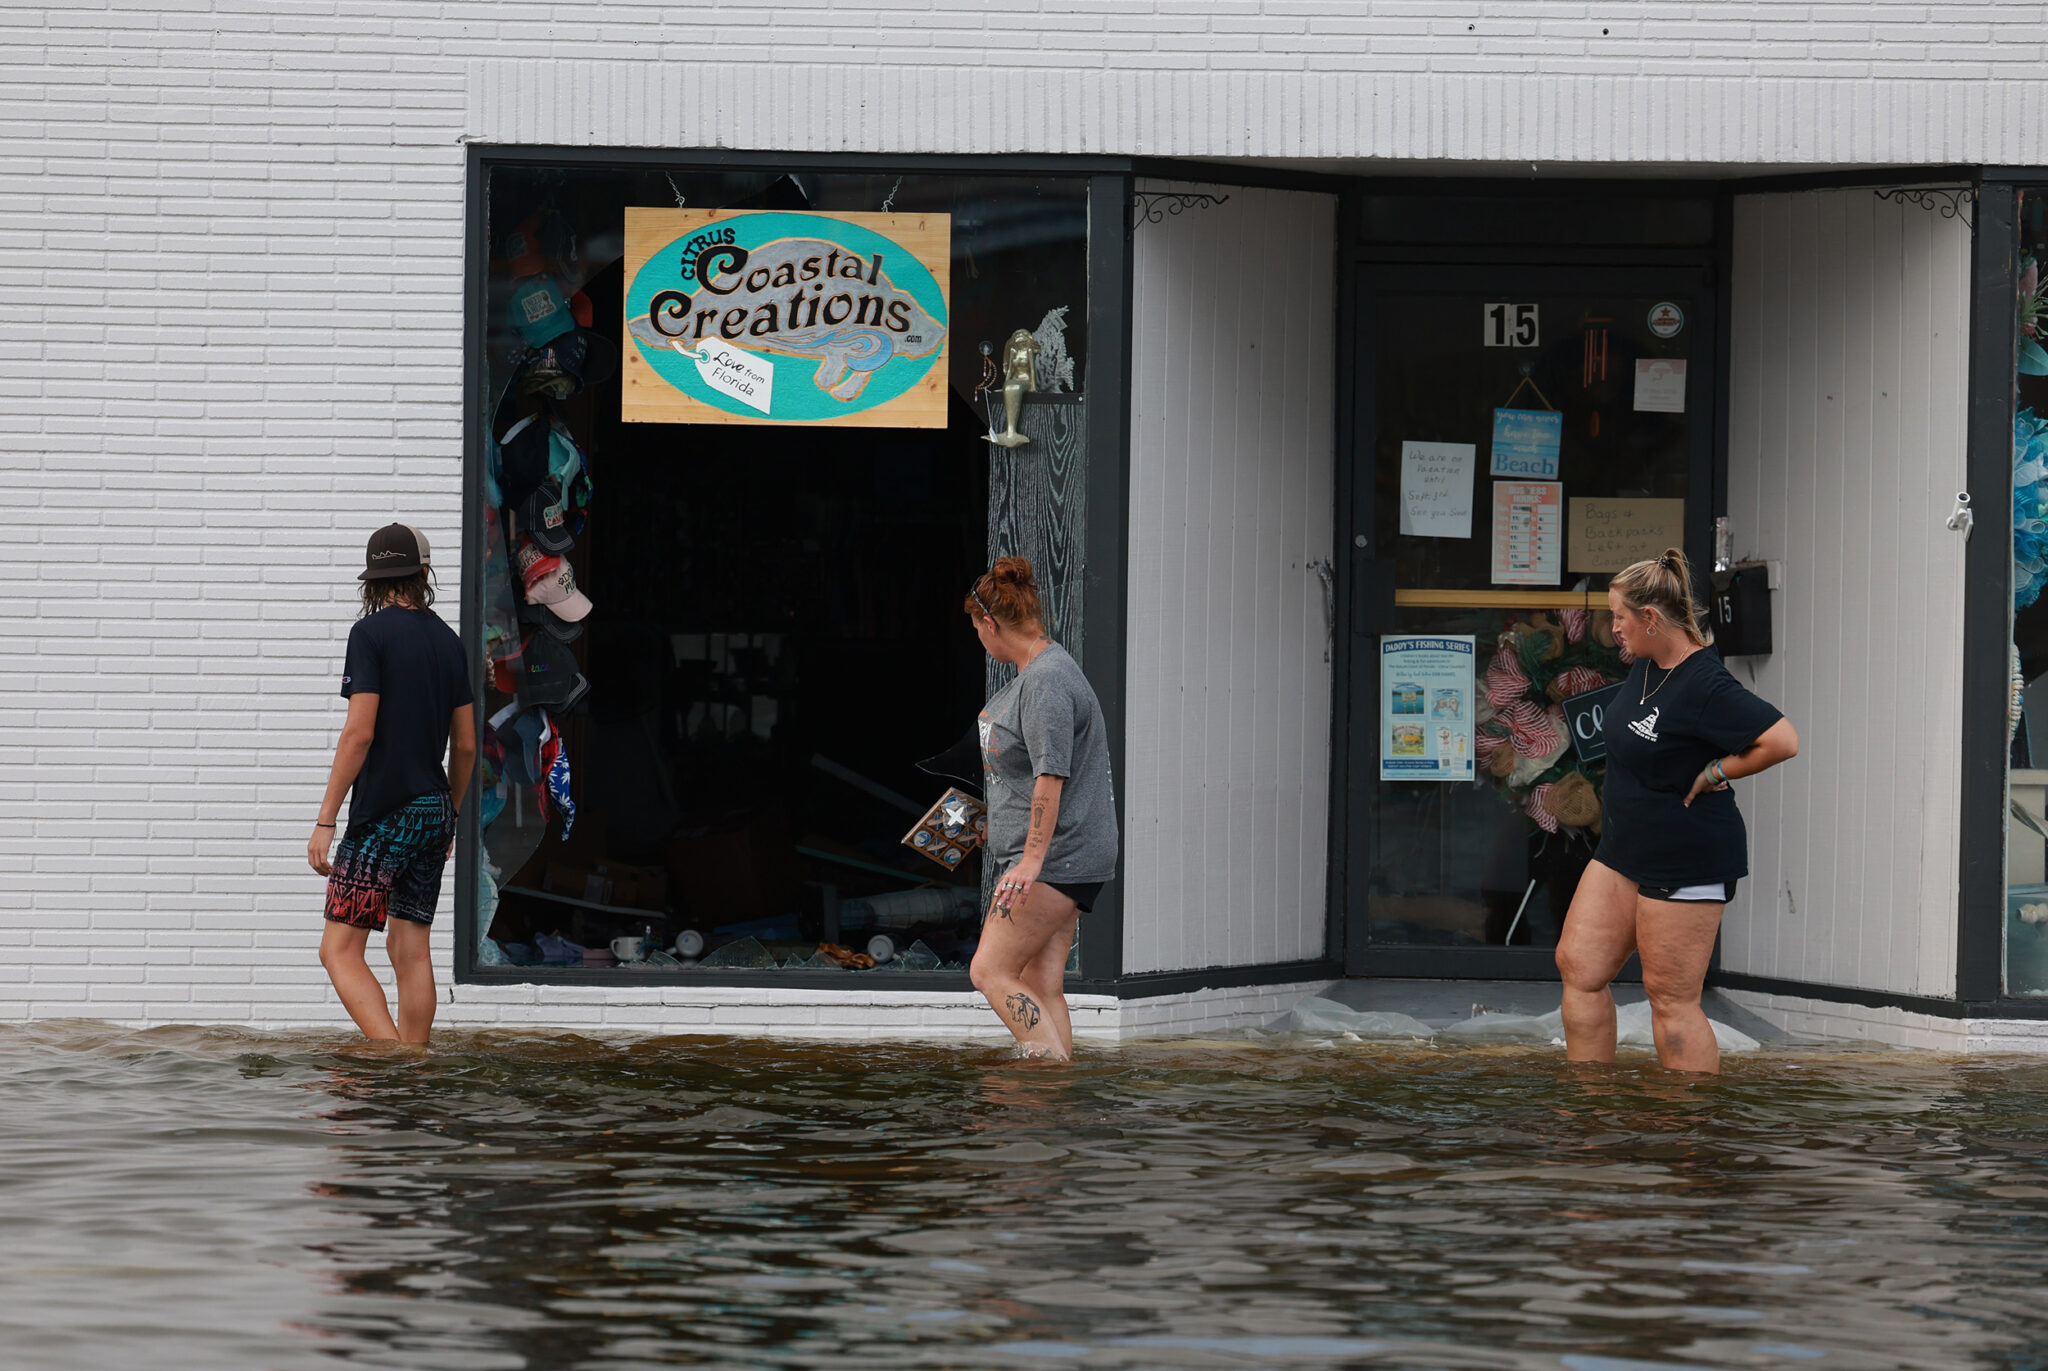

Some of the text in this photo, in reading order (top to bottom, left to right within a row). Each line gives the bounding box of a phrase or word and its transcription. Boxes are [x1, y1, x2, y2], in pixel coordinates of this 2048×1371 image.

[681, 226, 736, 281] CITRUS
[696, 245, 884, 296] Coastal
[649, 283, 912, 340] Creations
[1491, 305, 1537, 345] 15
[711, 367, 755, 397] Florida
[713, 351, 766, 384] Love from
[1409, 449, 1425, 461] We
[1494, 453, 1555, 475] Beach
[1585, 502, 1617, 524] Bags
[1718, 596, 1732, 625] 15
[1385, 640, 1470, 652] DADDY'S FISHING SERIES
